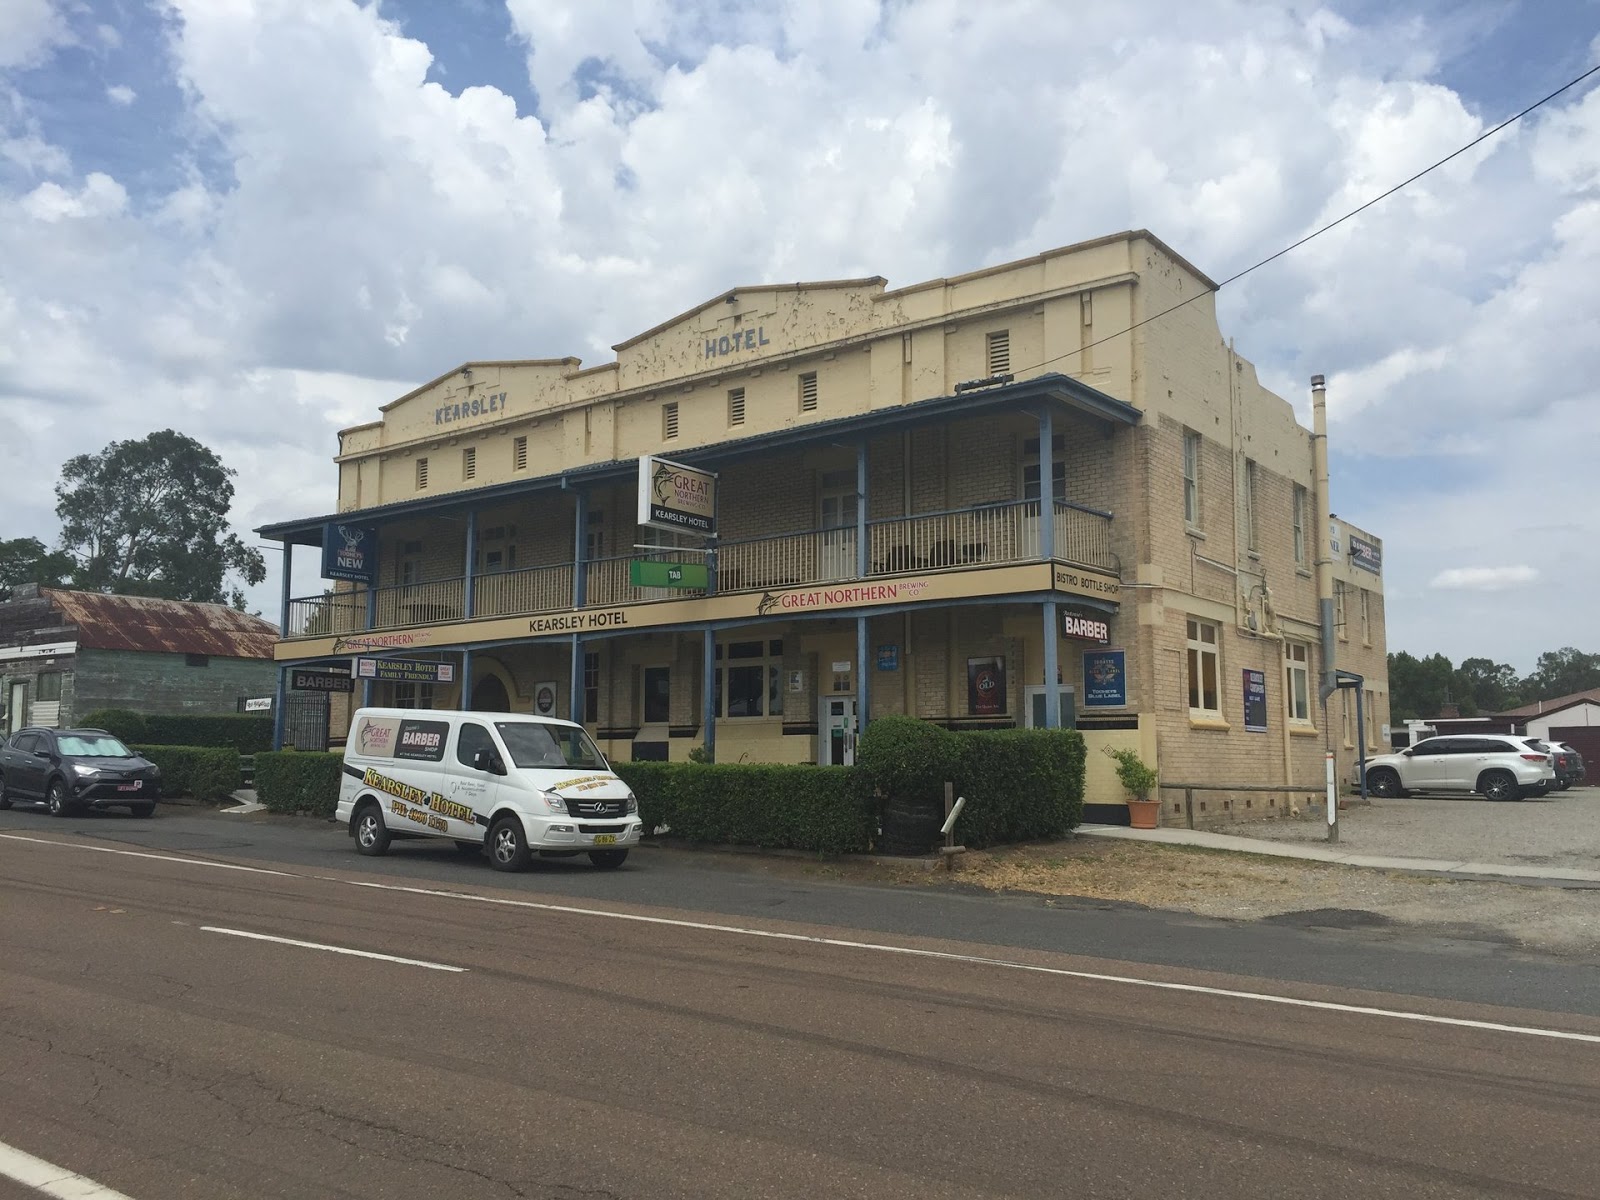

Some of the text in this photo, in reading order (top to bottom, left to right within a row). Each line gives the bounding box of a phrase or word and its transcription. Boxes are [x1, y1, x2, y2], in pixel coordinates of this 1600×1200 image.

[435, 326, 770, 426] KEARSLEY HOTEL
[674, 474, 710, 496] GREAT
[674, 489, 709, 504] NORTHERN
[655, 509, 709, 529] KEARSLEY HOTEL
[337, 556, 363, 569] NEW
[329, 571, 354, 579] KEARSLEY
[668, 570, 681, 579] TAB
[1056, 572, 1119, 595] BISTRO BOTTLE SHOP
[781, 592, 822, 608] GREAT
[824, 584, 897, 604] NORTHERN
[899, 581, 929, 591] BREWING
[529, 611, 628, 633] KEARSLEY HOTEL
[1064, 616, 1108, 640] BARBER
[346, 638, 371, 650] GREAT
[371, 633, 414, 647] NORTHERN
[377, 660, 415, 671] KEARSLEY
[415, 663, 438, 673] HOTEL
[296, 675, 351, 690] BARBER
[380, 670, 402, 679] FAMILY
[404, 671, 434, 680] FRIENDLY
[979, 681, 995, 690] OLD
[371, 728, 392, 737] GREAT
[402, 731, 441, 747] BARBER
[363, 767, 476, 825] KEARSLEY HOTEL
[408, 808, 428, 826] 4990
